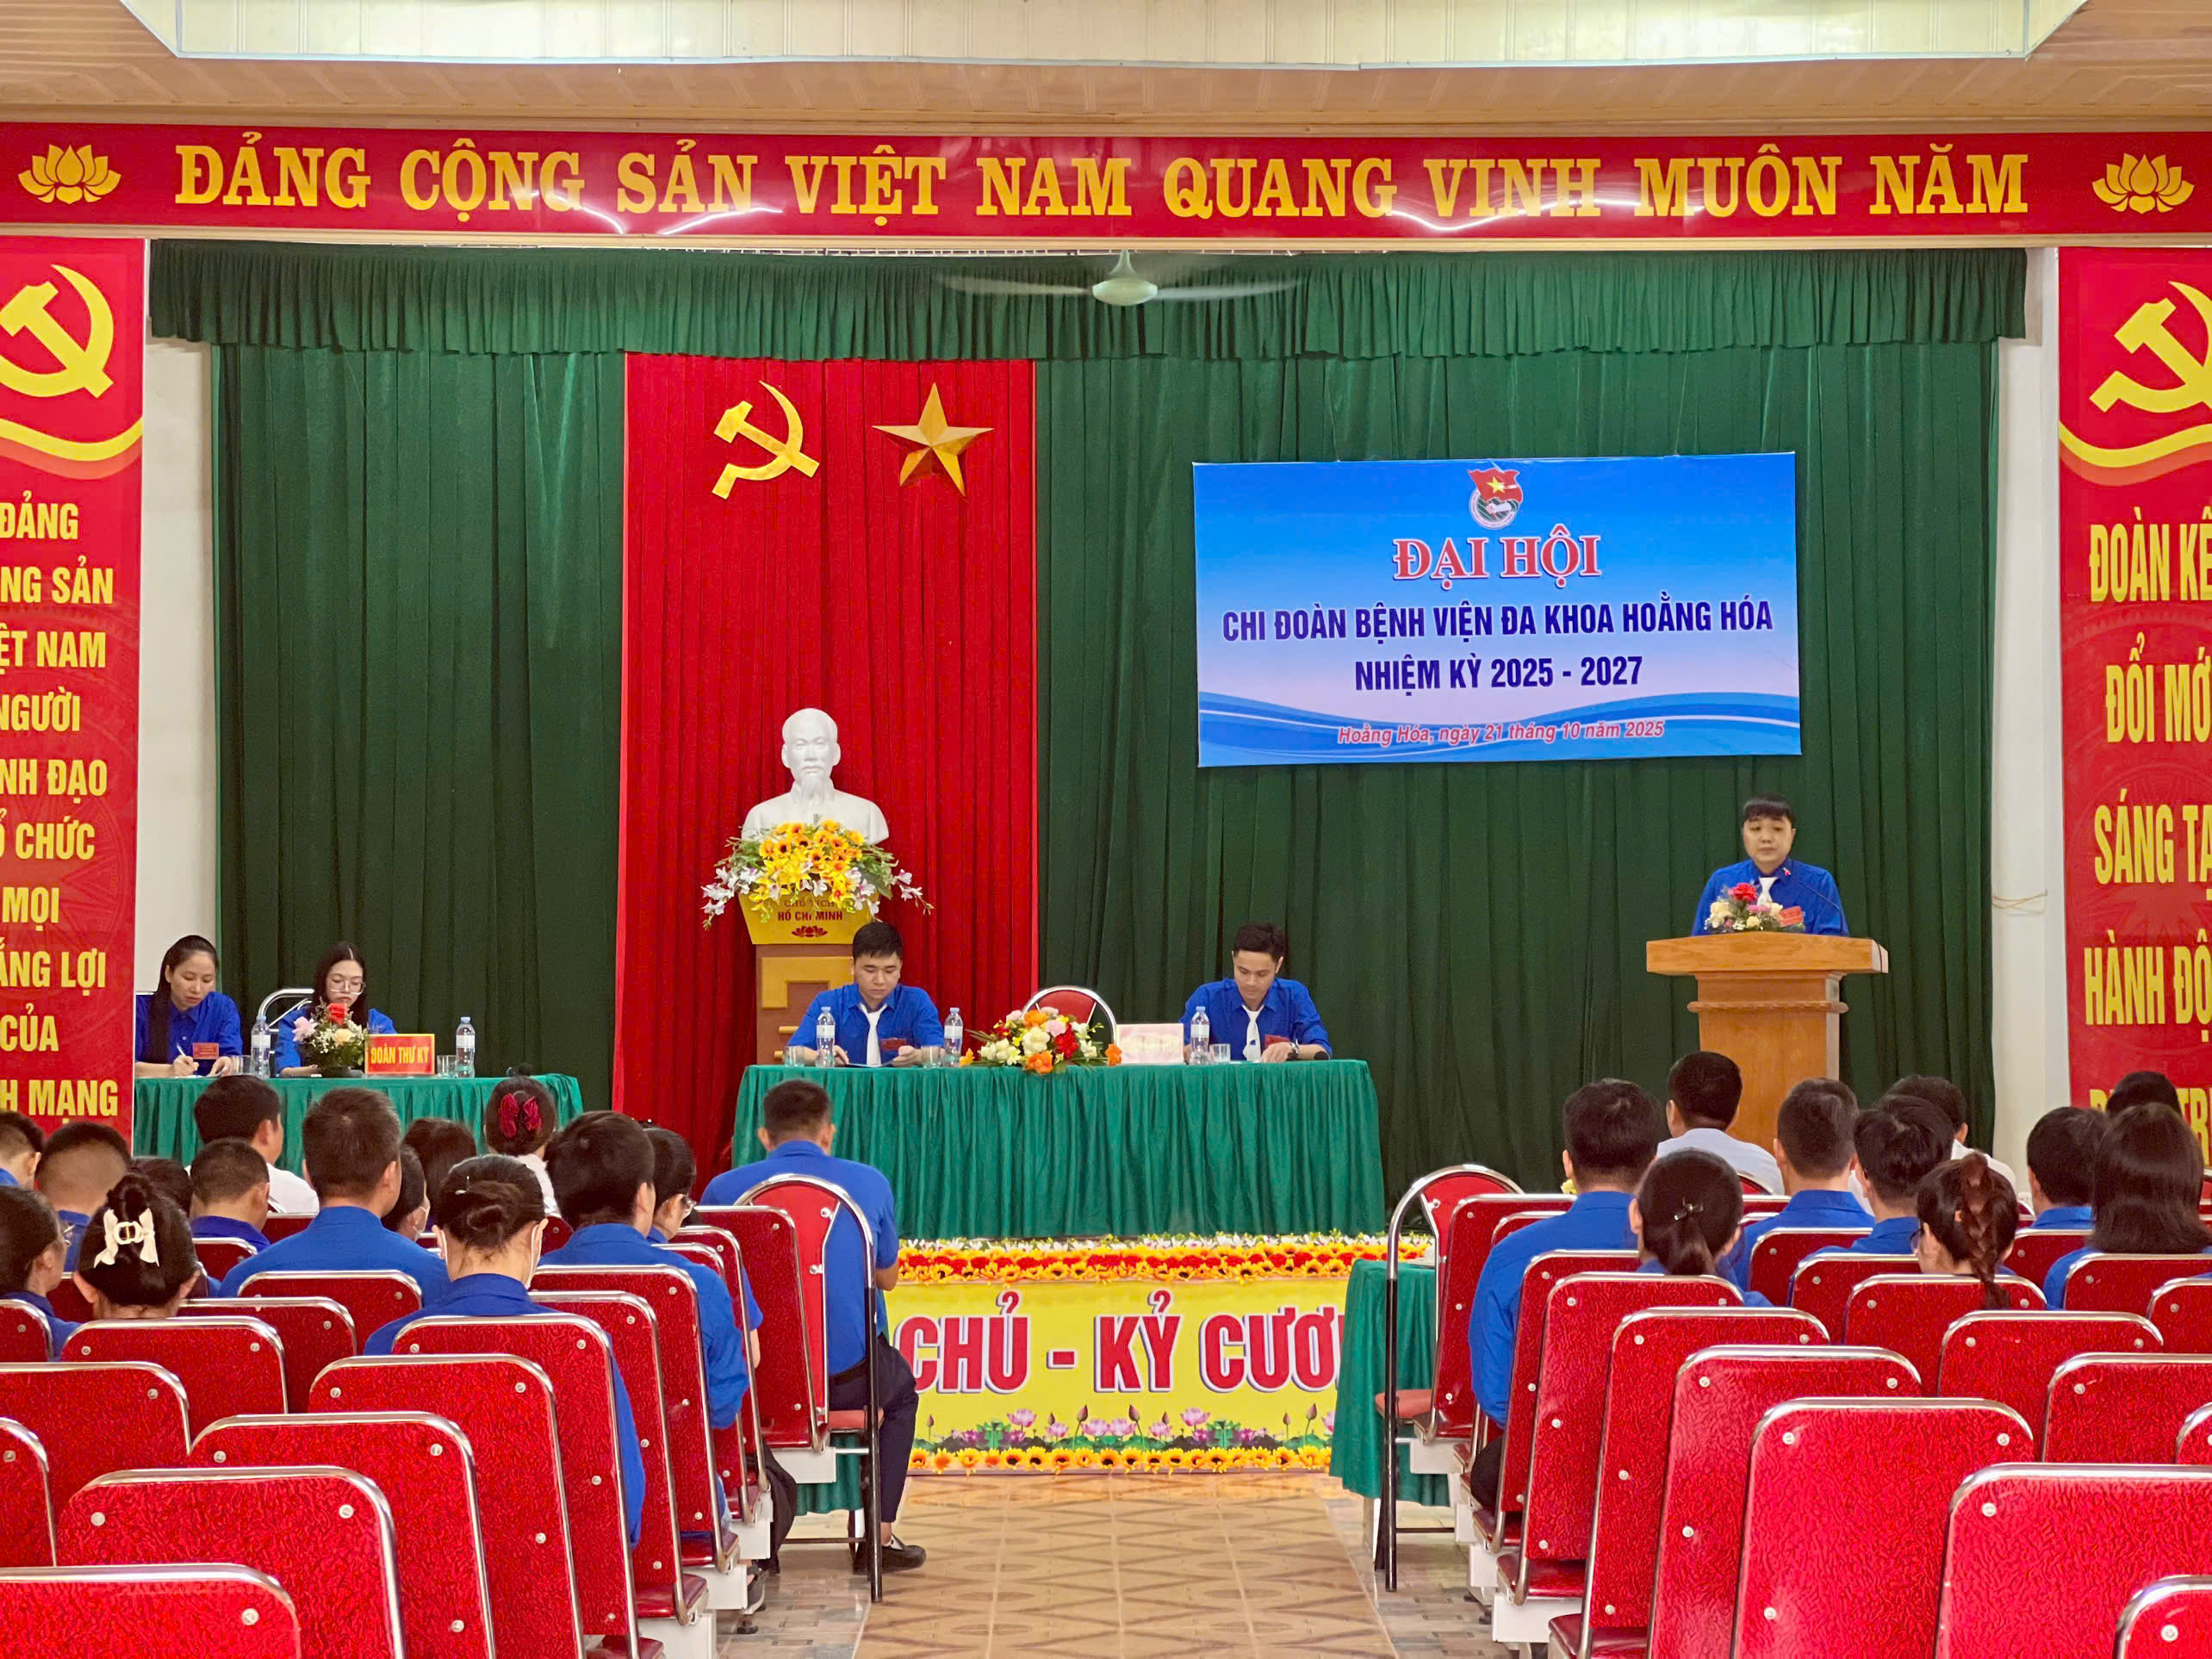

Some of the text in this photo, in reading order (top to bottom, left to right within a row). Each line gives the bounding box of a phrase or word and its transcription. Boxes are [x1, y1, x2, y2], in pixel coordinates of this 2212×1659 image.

[176, 132, 2028, 227] ĐẢNG CỘNG SẢN VIỆT NAM QUANG VINH MUÔN NĂM
[0, 490, 78, 539] ĐẢNG
[1393, 524, 1602, 591] ĐẠI HỘI
[2089, 506, 2170, 602] ĐOÀN
[52, 556, 113, 604] SẢN
[1223, 591, 1773, 644] CHI ĐOÀN BỆNH VIỆN ĐA KHOA HOẰNG HÓA
[37, 631, 106, 668] NAM
[1355, 654, 1440, 696] NHIỆM
[1450, 652, 1482, 688] KỲ
[1491, 658, 1553, 688] 2025
[1581, 656, 1643, 686] 2027
[2106, 632, 2212, 743] ĐỔI MỚ
[1339, 721, 1664, 746] Hoằng Hóa, ngày 21 tháng 10 năm 2025
[47, 759, 108, 804] ĐẠO
[16, 816, 96, 860] CHỨC
[2094, 788, 2174, 885] SÁNG
[3, 886, 60, 932] MỌI
[816, 910, 843, 921] MINH
[61, 948, 107, 996] LỢI
[2085, 929, 2212, 1042] HÀNH ĐỘ
[0, 1003, 59, 1052] CỦA
[28, 1080, 118, 1125] MẠNG
[894, 1290, 1030, 1393] CHỦ
[1095, 1289, 1182, 1392] KỶ
[1202, 1305, 1345, 1392] CƯƠ
